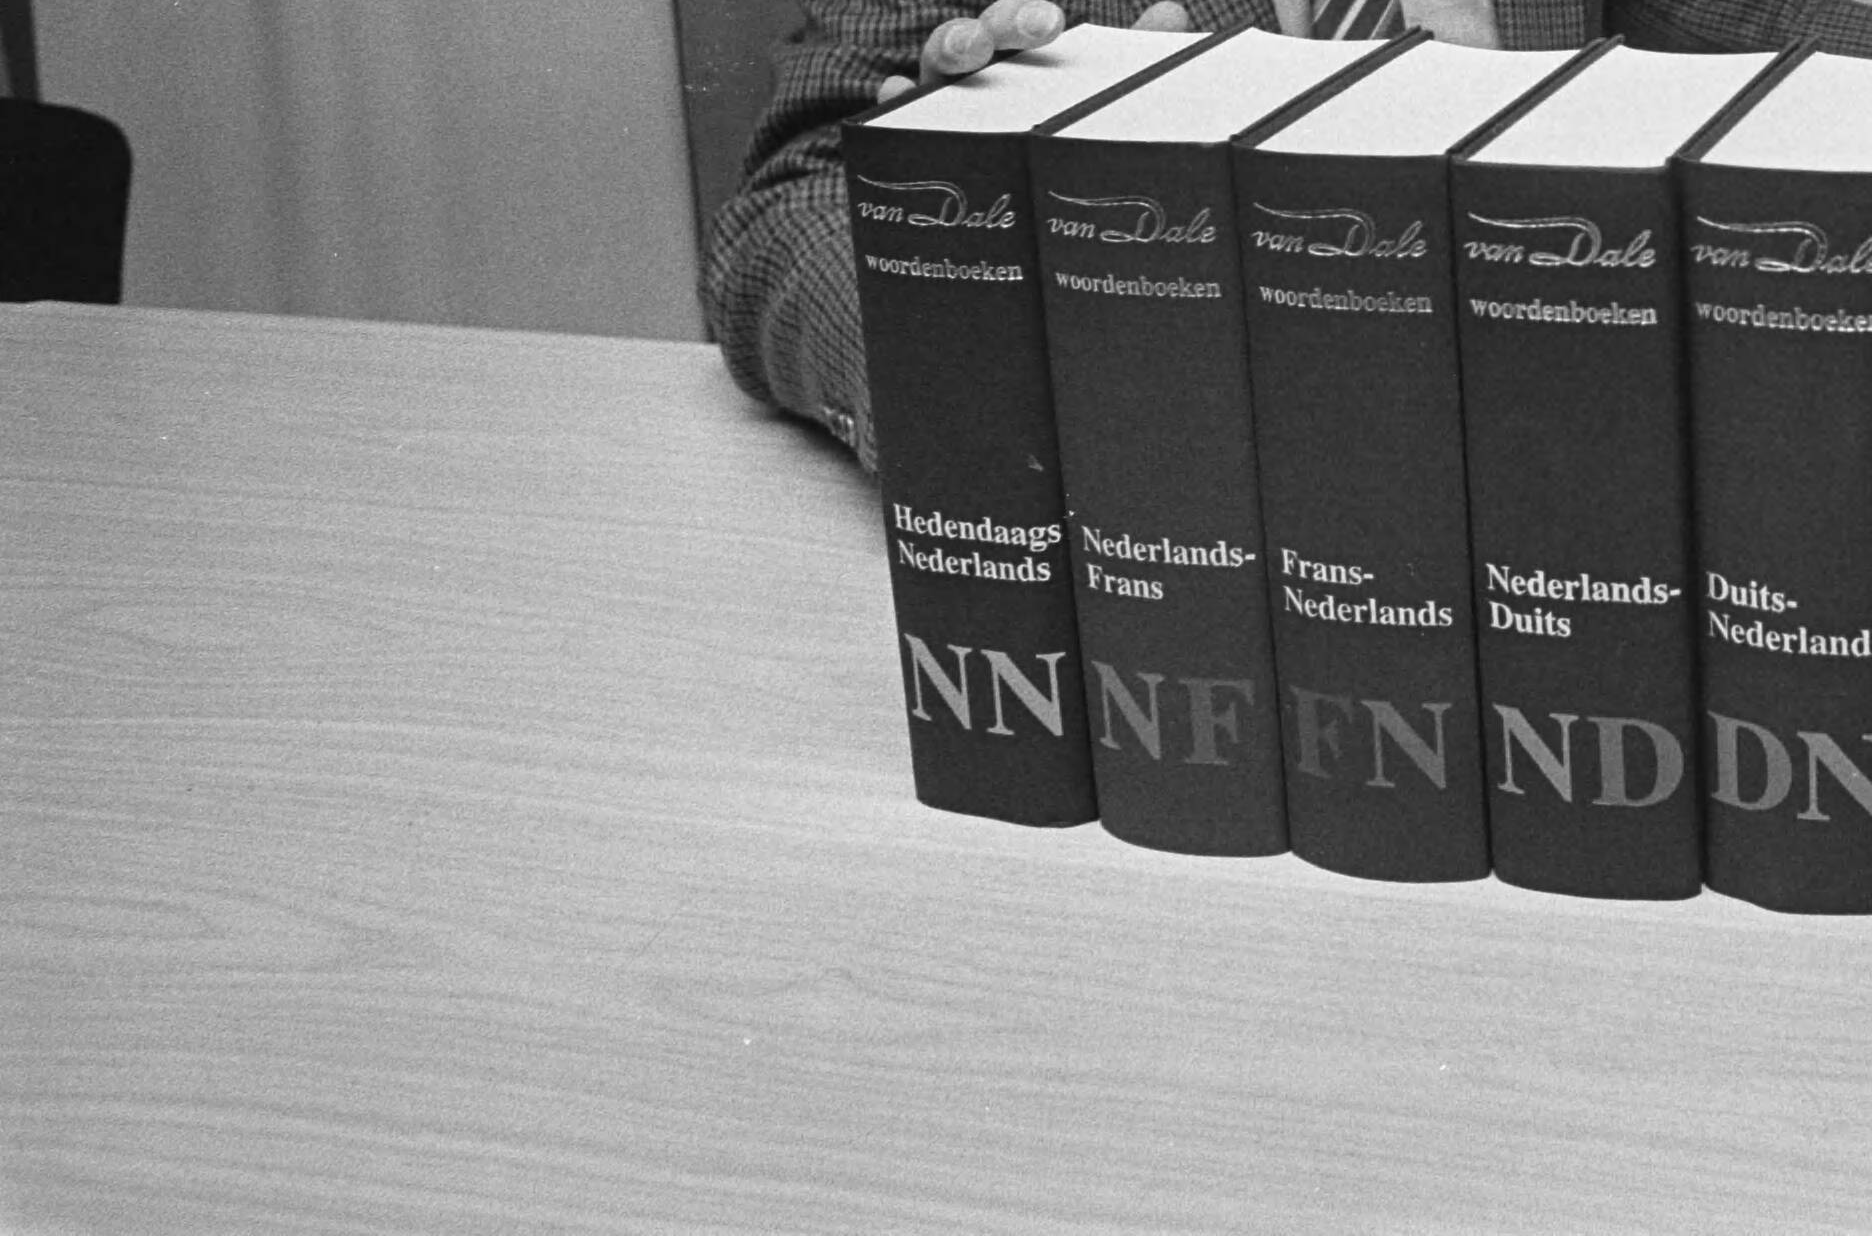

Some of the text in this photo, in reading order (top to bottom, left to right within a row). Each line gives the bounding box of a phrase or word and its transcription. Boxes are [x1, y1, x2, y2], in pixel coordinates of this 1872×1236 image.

[858, 175, 1016, 228] van Dale
[1047, 191, 1216, 243] van Dale
[1253, 202, 1428, 258] van Dale
[1464, 213, 1656, 268] van Dale
[866, 254, 1023, 281] woordenboeken
[1690, 241, 1749, 267] van
[1055, 269, 1221, 298] woordenboeken
[1260, 284, 1433, 313] woordenboeken
[1470, 296, 1658, 325] woordenboeken
[893, 503, 1062, 551] Hedendaags
[1081, 525, 1256, 568] Nederlands-
[897, 540, 1052, 582] Nederlands
[1086, 564, 1164, 600] Frans
[1281, 548, 1374, 585] Frans-
[1485, 563, 1682, 605] Nederlands-
[1706, 571, 1798, 613] Duits-
[1283, 586, 1453, 627] Nederlands
[1488, 600, 1572, 638] Duits
[903, 632, 1067, 737] NN
[1091, 659, 1256, 765] NF
[1289, 684, 1453, 790] FN
[1492, 703, 1685, 807] ND
